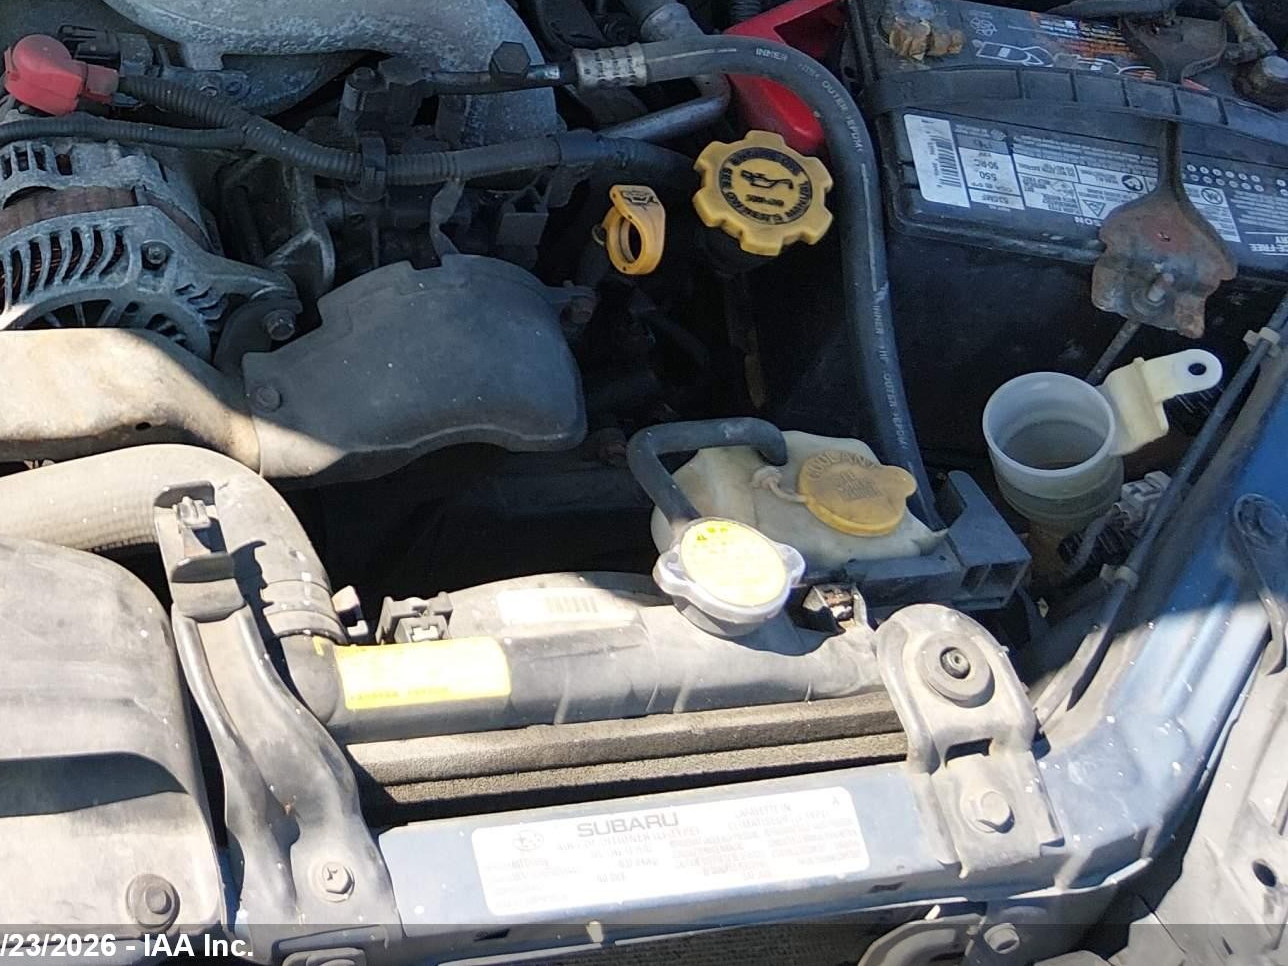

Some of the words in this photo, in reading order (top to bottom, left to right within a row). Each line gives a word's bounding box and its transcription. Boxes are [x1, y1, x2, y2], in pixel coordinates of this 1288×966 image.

[821, 80, 849, 112] OUTER
[872, 305, 884, 336] INNER
[883, 373, 899, 409] OUTER
[577, 812, 679, 838] SUBARU
